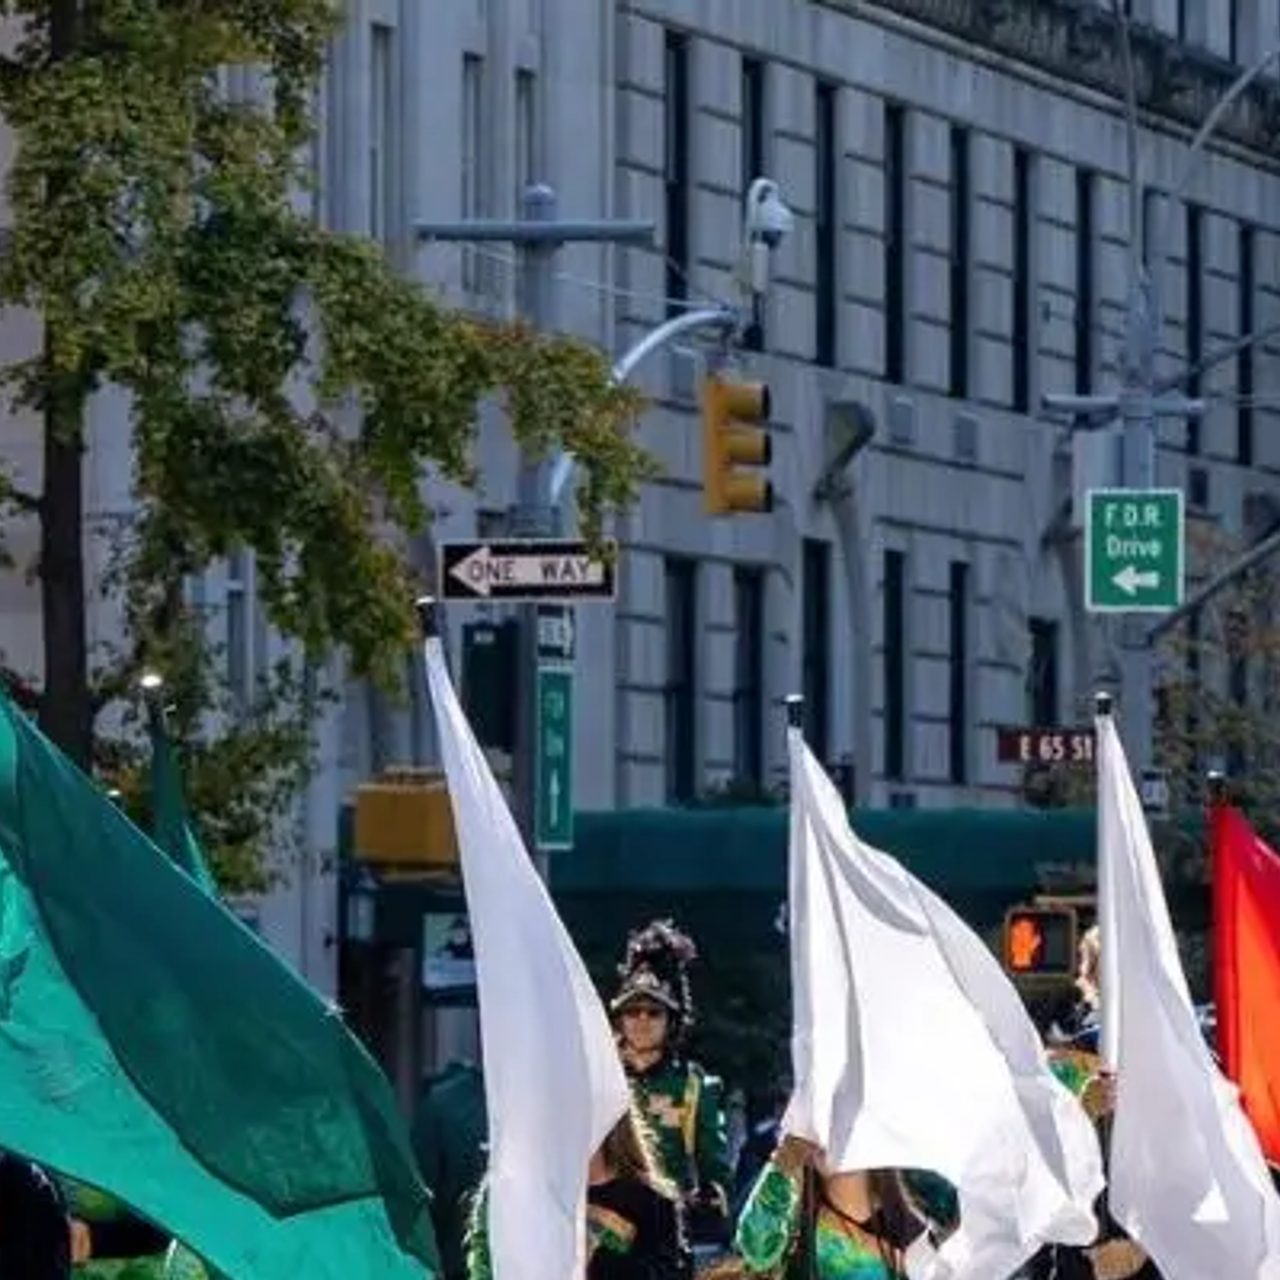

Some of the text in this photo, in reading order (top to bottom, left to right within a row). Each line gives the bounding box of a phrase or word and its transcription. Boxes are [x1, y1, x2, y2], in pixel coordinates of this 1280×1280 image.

[1106, 535, 1162, 558] Drive
[469, 558, 590, 582] ONE WAY
[1019, 735, 1031, 761] E
[1039, 734, 1065, 761] 65
